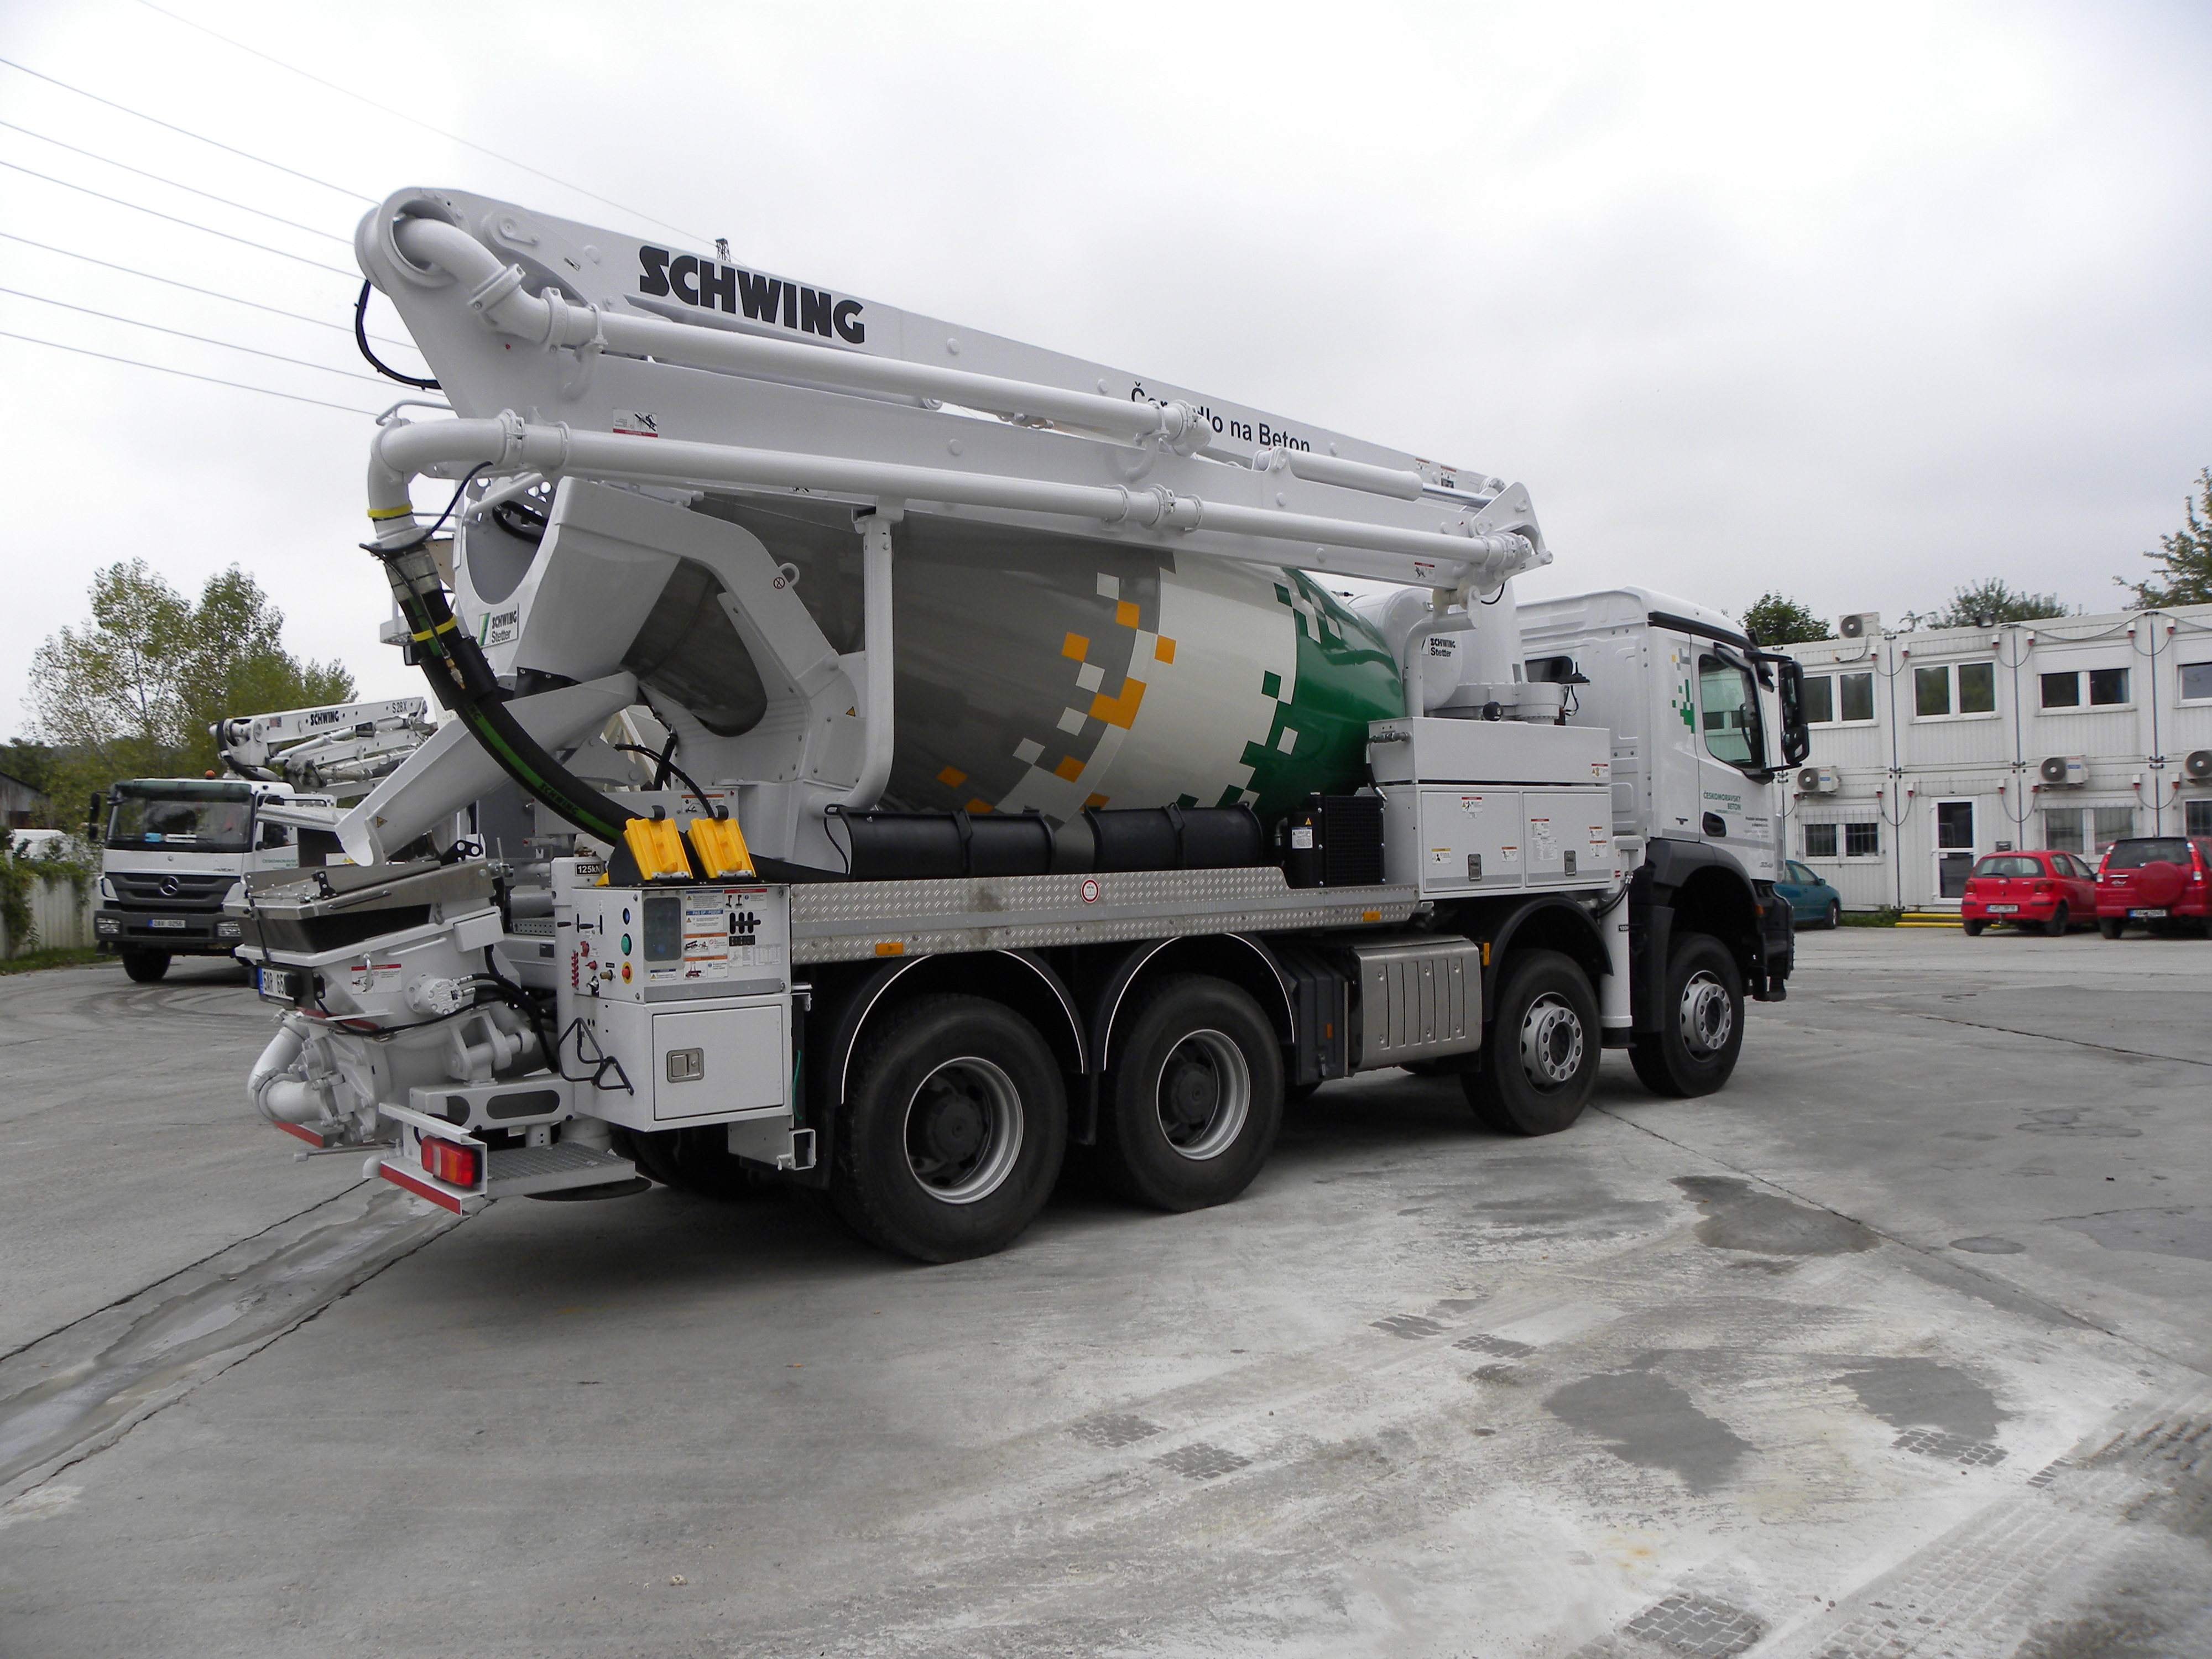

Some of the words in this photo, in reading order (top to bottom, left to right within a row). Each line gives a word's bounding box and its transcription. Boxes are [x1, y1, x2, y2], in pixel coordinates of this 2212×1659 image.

[639, 245, 865, 344] SCHWING
[1230, 420, 1252, 441] na
[1259, 422, 1310, 453] Beton
[492, 610, 517, 629] SCHWING
[491, 630, 511, 643] Stetter
[1430, 638, 1455, 648] SCHWING
[1431, 647, 1452, 657] Stetter
[392, 701, 408, 714] S28X
[310, 710, 340, 726] SCHWING
[1727, 802, 1741, 810] BETON
[578, 865, 601, 874] 125kN
